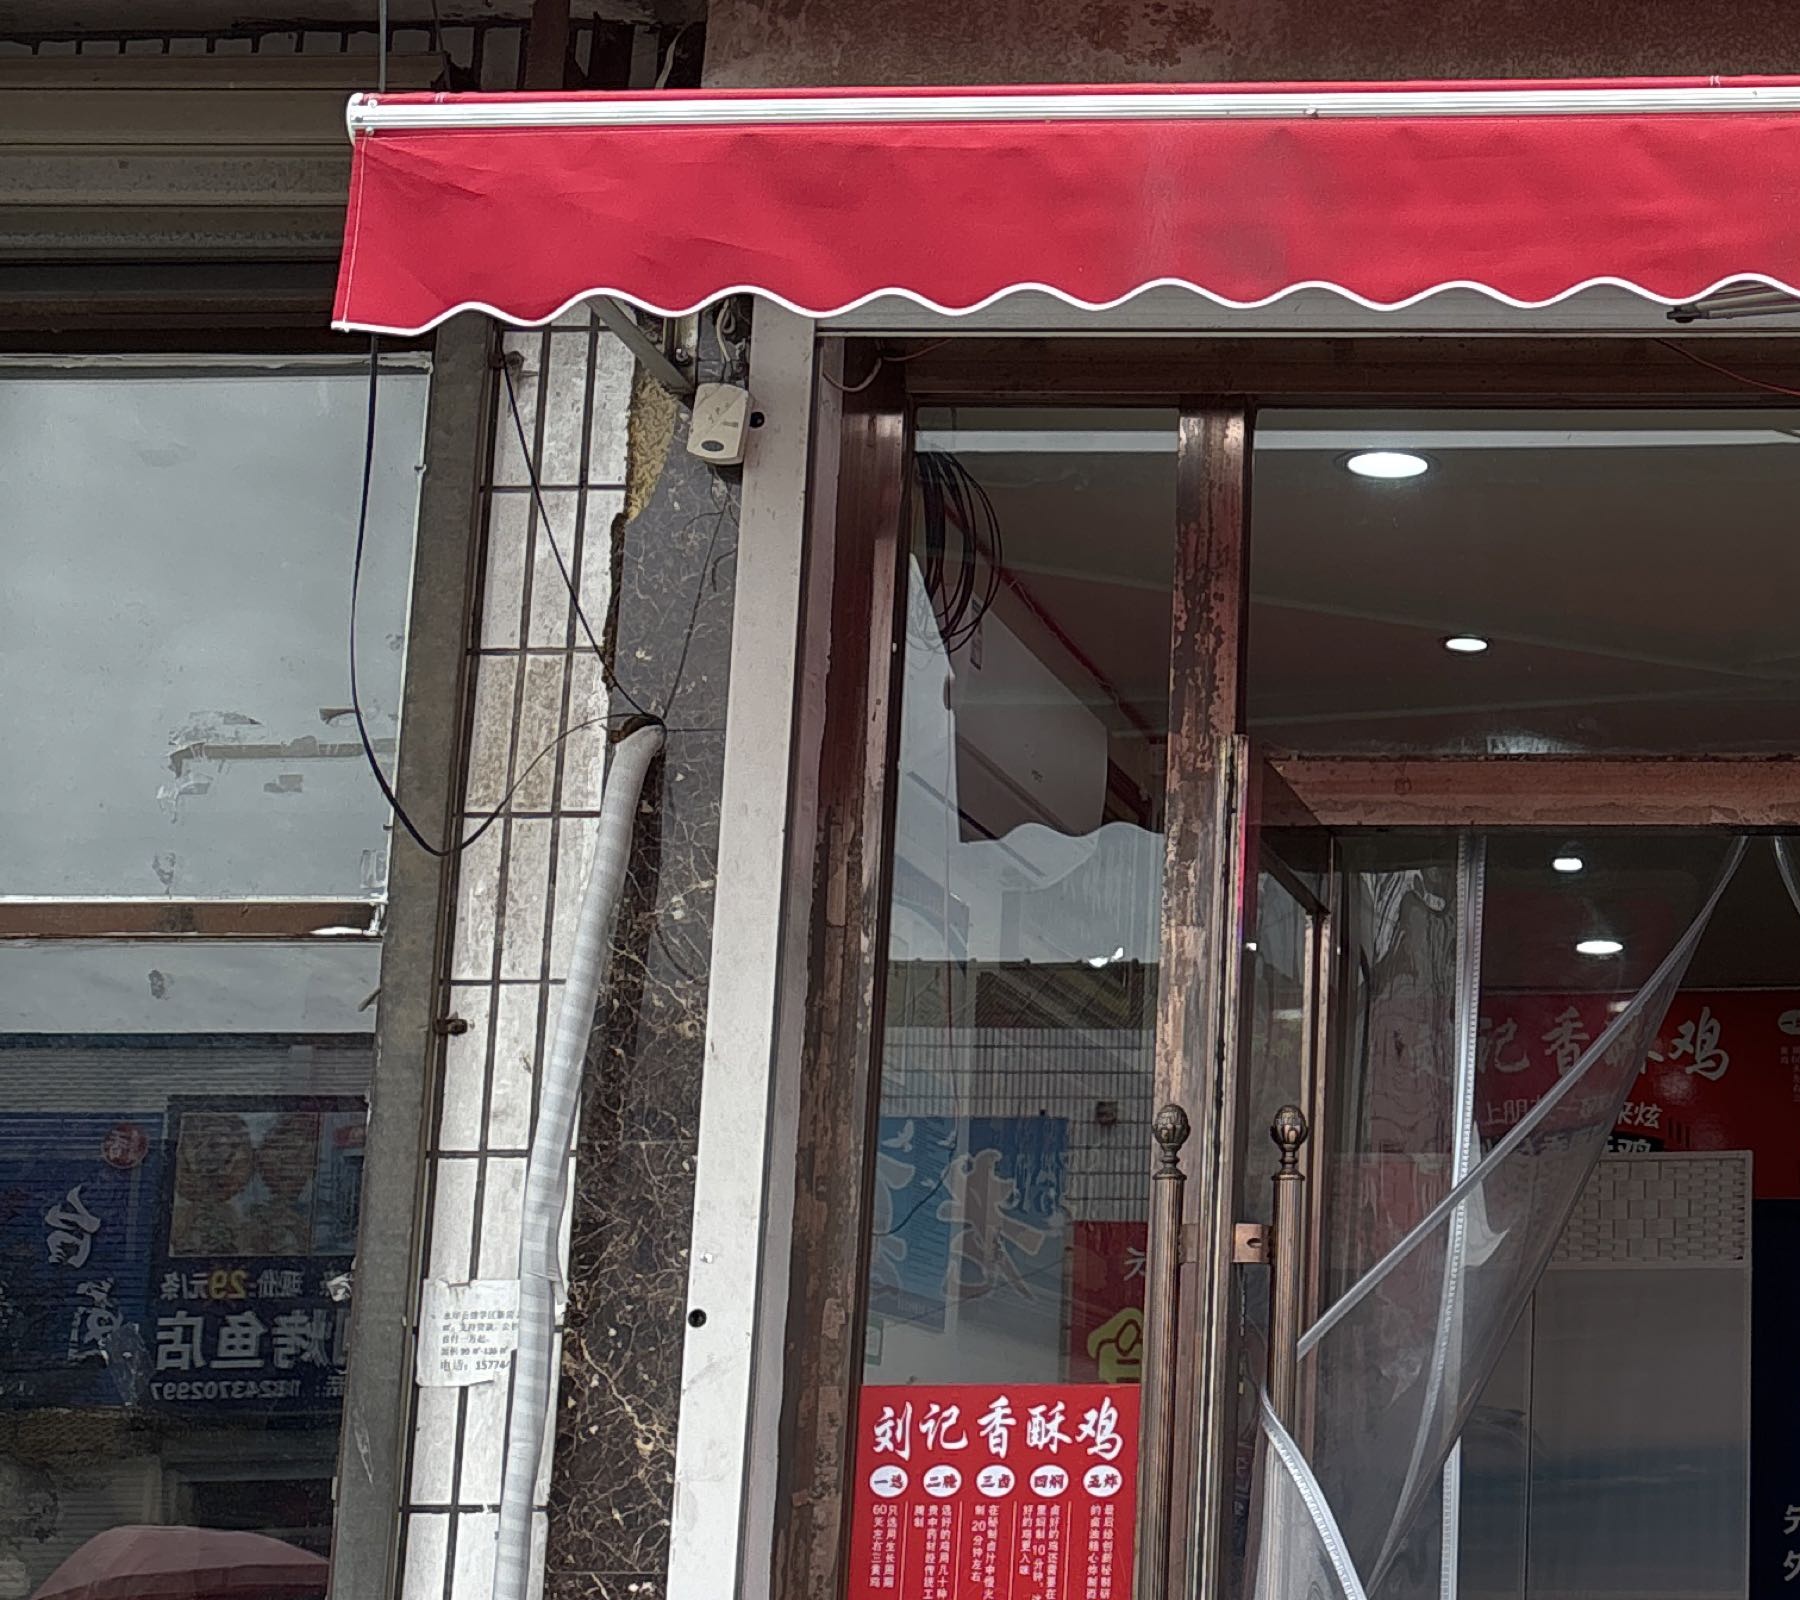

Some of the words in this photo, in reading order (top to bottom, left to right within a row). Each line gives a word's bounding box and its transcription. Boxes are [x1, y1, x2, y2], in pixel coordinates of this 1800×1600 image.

[873, 1394, 1124, 1461] 刘记香酥鸡
[980, 1473, 1012, 1489] 三卤
[1087, 1472, 1119, 1490] 五炸
